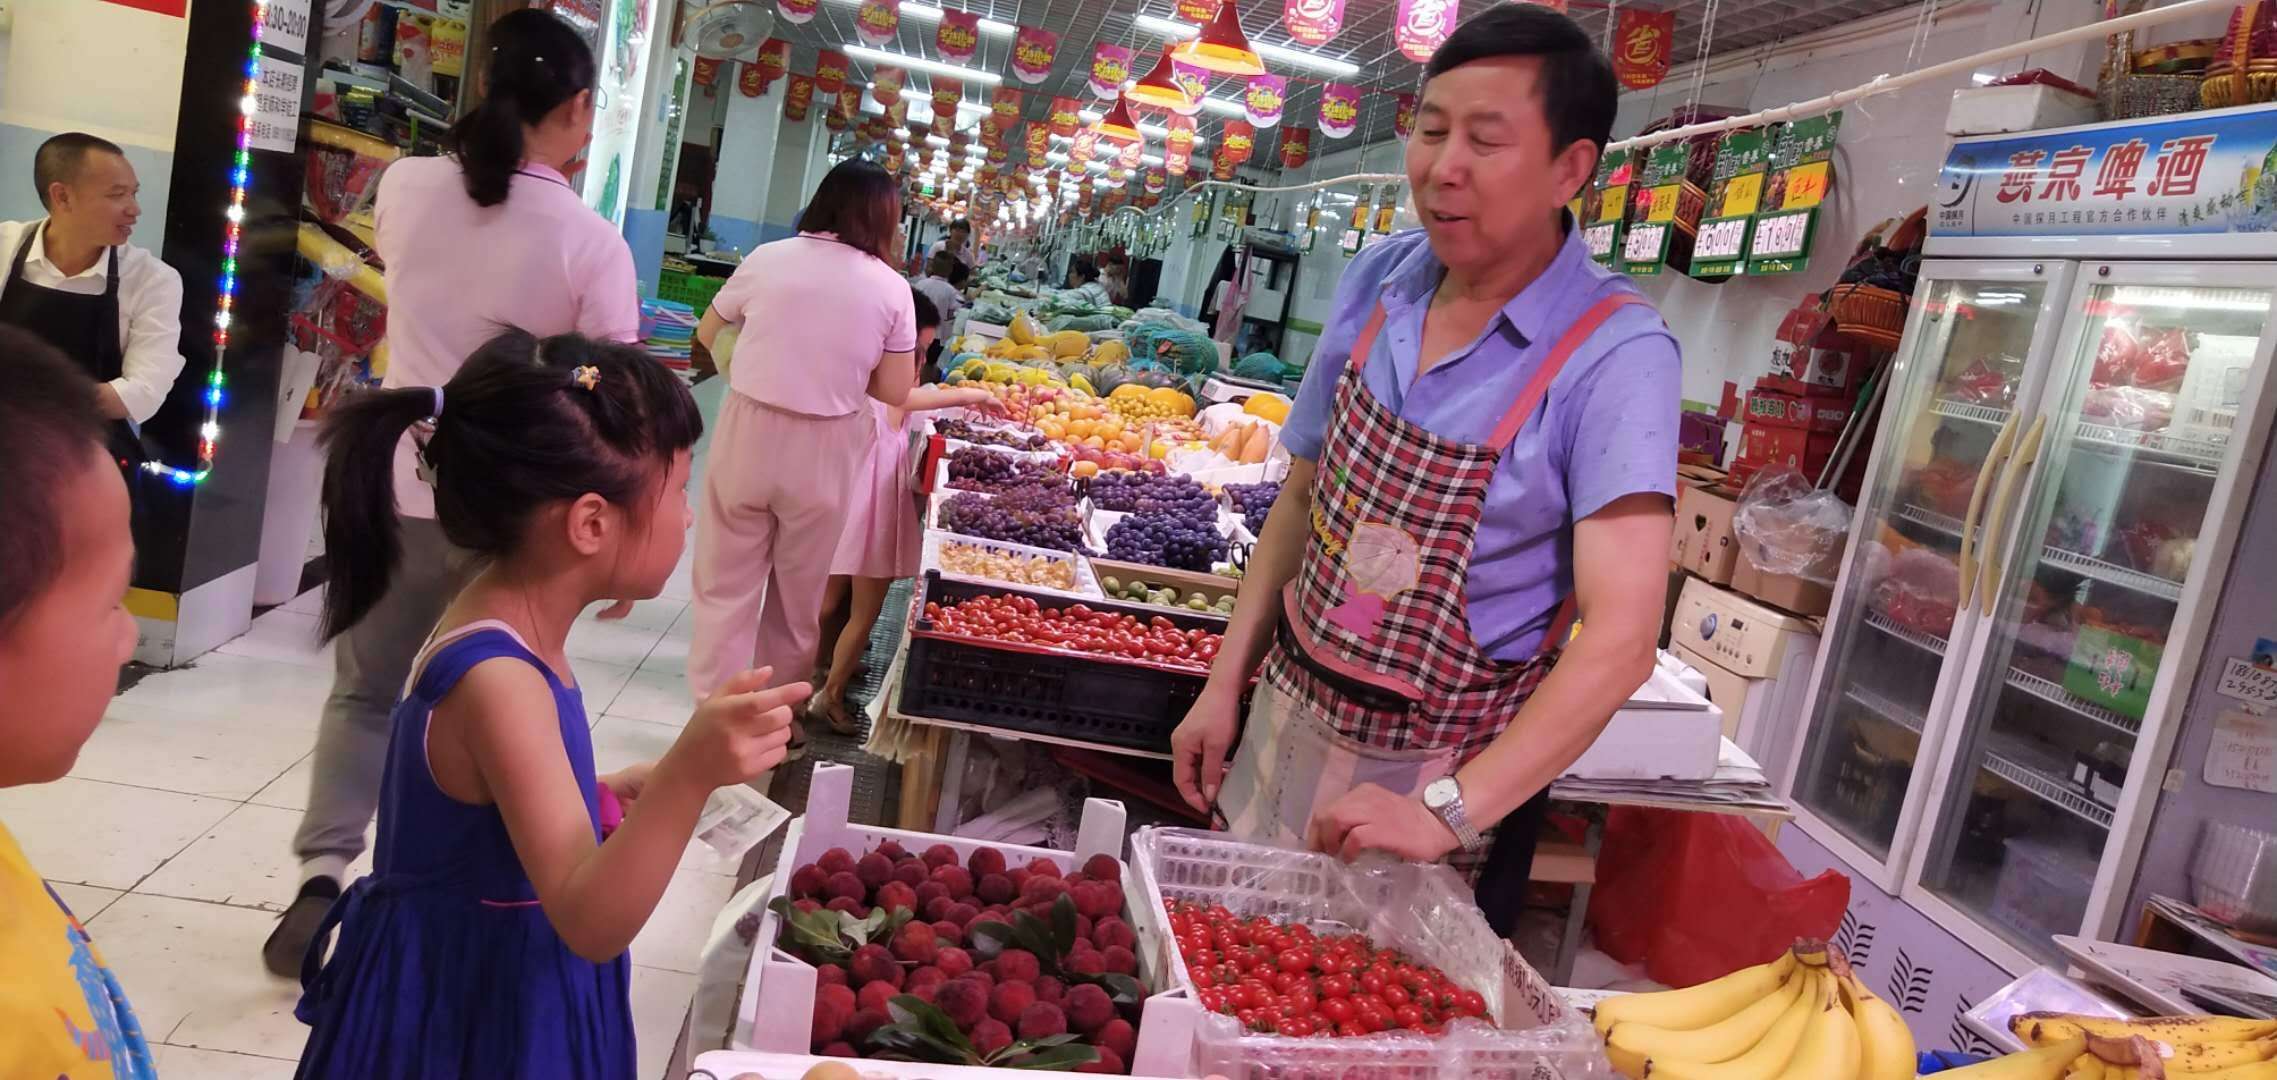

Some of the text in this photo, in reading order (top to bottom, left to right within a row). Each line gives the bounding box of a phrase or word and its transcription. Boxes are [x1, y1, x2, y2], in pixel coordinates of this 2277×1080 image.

[1624, 24, 1662, 65] 省
[1997, 135, 2217, 203] 燕京啤酒
[2012, 207, 2169, 226] 中国探月工程官方合作伙伴
